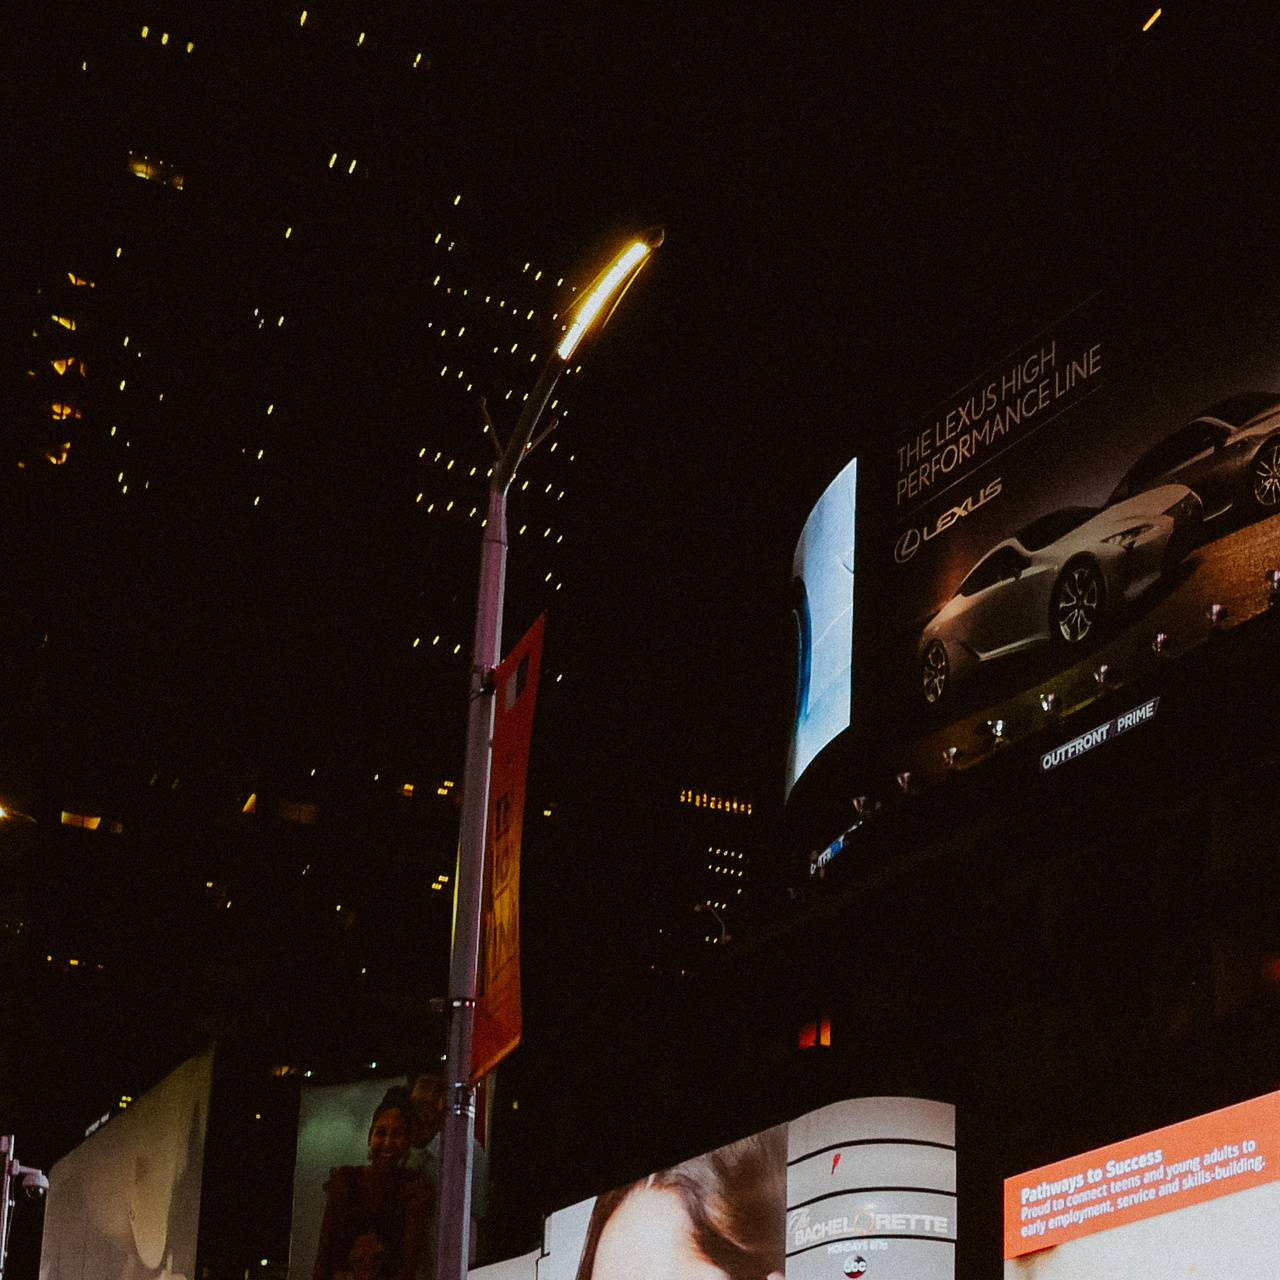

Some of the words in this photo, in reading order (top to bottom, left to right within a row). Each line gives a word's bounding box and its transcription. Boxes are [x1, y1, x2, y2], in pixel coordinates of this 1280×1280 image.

[897, 429, 931, 472] THE
[936, 382, 997, 446] LEXUS
[1002, 341, 1055, 400] HIGH
[897, 379, 1050, 505] PERFORMANCE
[1056, 344, 1101, 398] LINE
[924, 477, 1002, 540] LEXUS
[1042, 724, 1110, 770] OUTFRONT
[1117, 702, 1154, 731] PRIME
[1020, 1171, 1084, 1204] Pathways
[1087, 1166, 1103, 1184] to
[1106, 1149, 1163, 1179] Success
[1020, 1218, 1046, 1238] early
[1048, 1201, 1115, 1230] employment,
[1117, 1188, 1156, 1209] service
[1159, 1180, 1180, 1197] and
[1182, 1155, 1266, 1190] skills-building.
[1021, 1201, 1051, 1221] Proud
[1052, 1198, 1064, 1212] to
[1066, 1185, 1108, 1207] connect
[1110, 1175, 1141, 1194] teens
[1143, 1166, 1164, 1183] and
[1166, 1156, 1201, 1180] young
[1203, 1145, 1239, 1166] adults
[1242, 1140, 1256, 1153] to
[795, 1209, 948, 1246] BACHELORETTE
